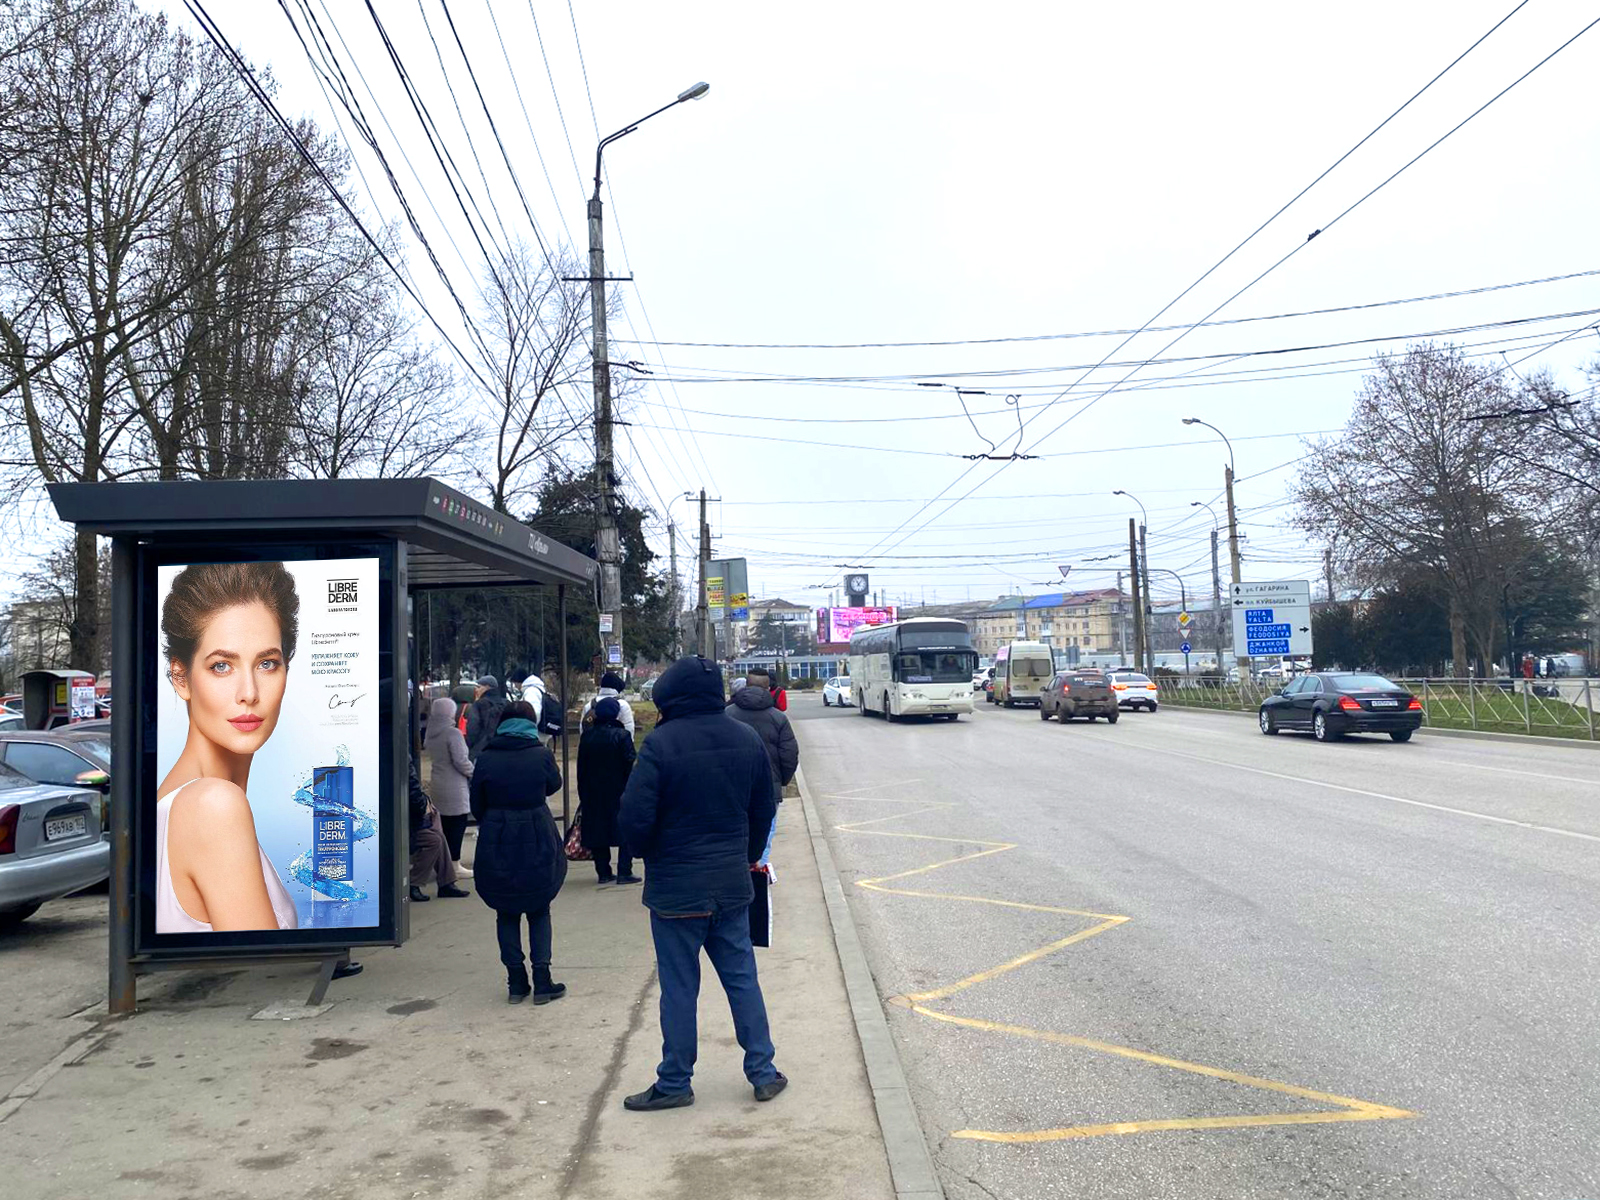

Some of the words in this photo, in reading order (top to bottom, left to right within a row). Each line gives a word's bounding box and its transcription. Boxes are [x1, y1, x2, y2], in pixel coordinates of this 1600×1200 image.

[328, 582, 358, 593] LIBRE
[328, 593, 358, 603] DERM
[1256, 597, 1297, 605] КУЙБЫШЕВА
[1249, 640, 1286, 648] ДЖАНКОЙ
[319, 820, 346, 830] LIBRE
[319, 831, 346, 840] DERM
